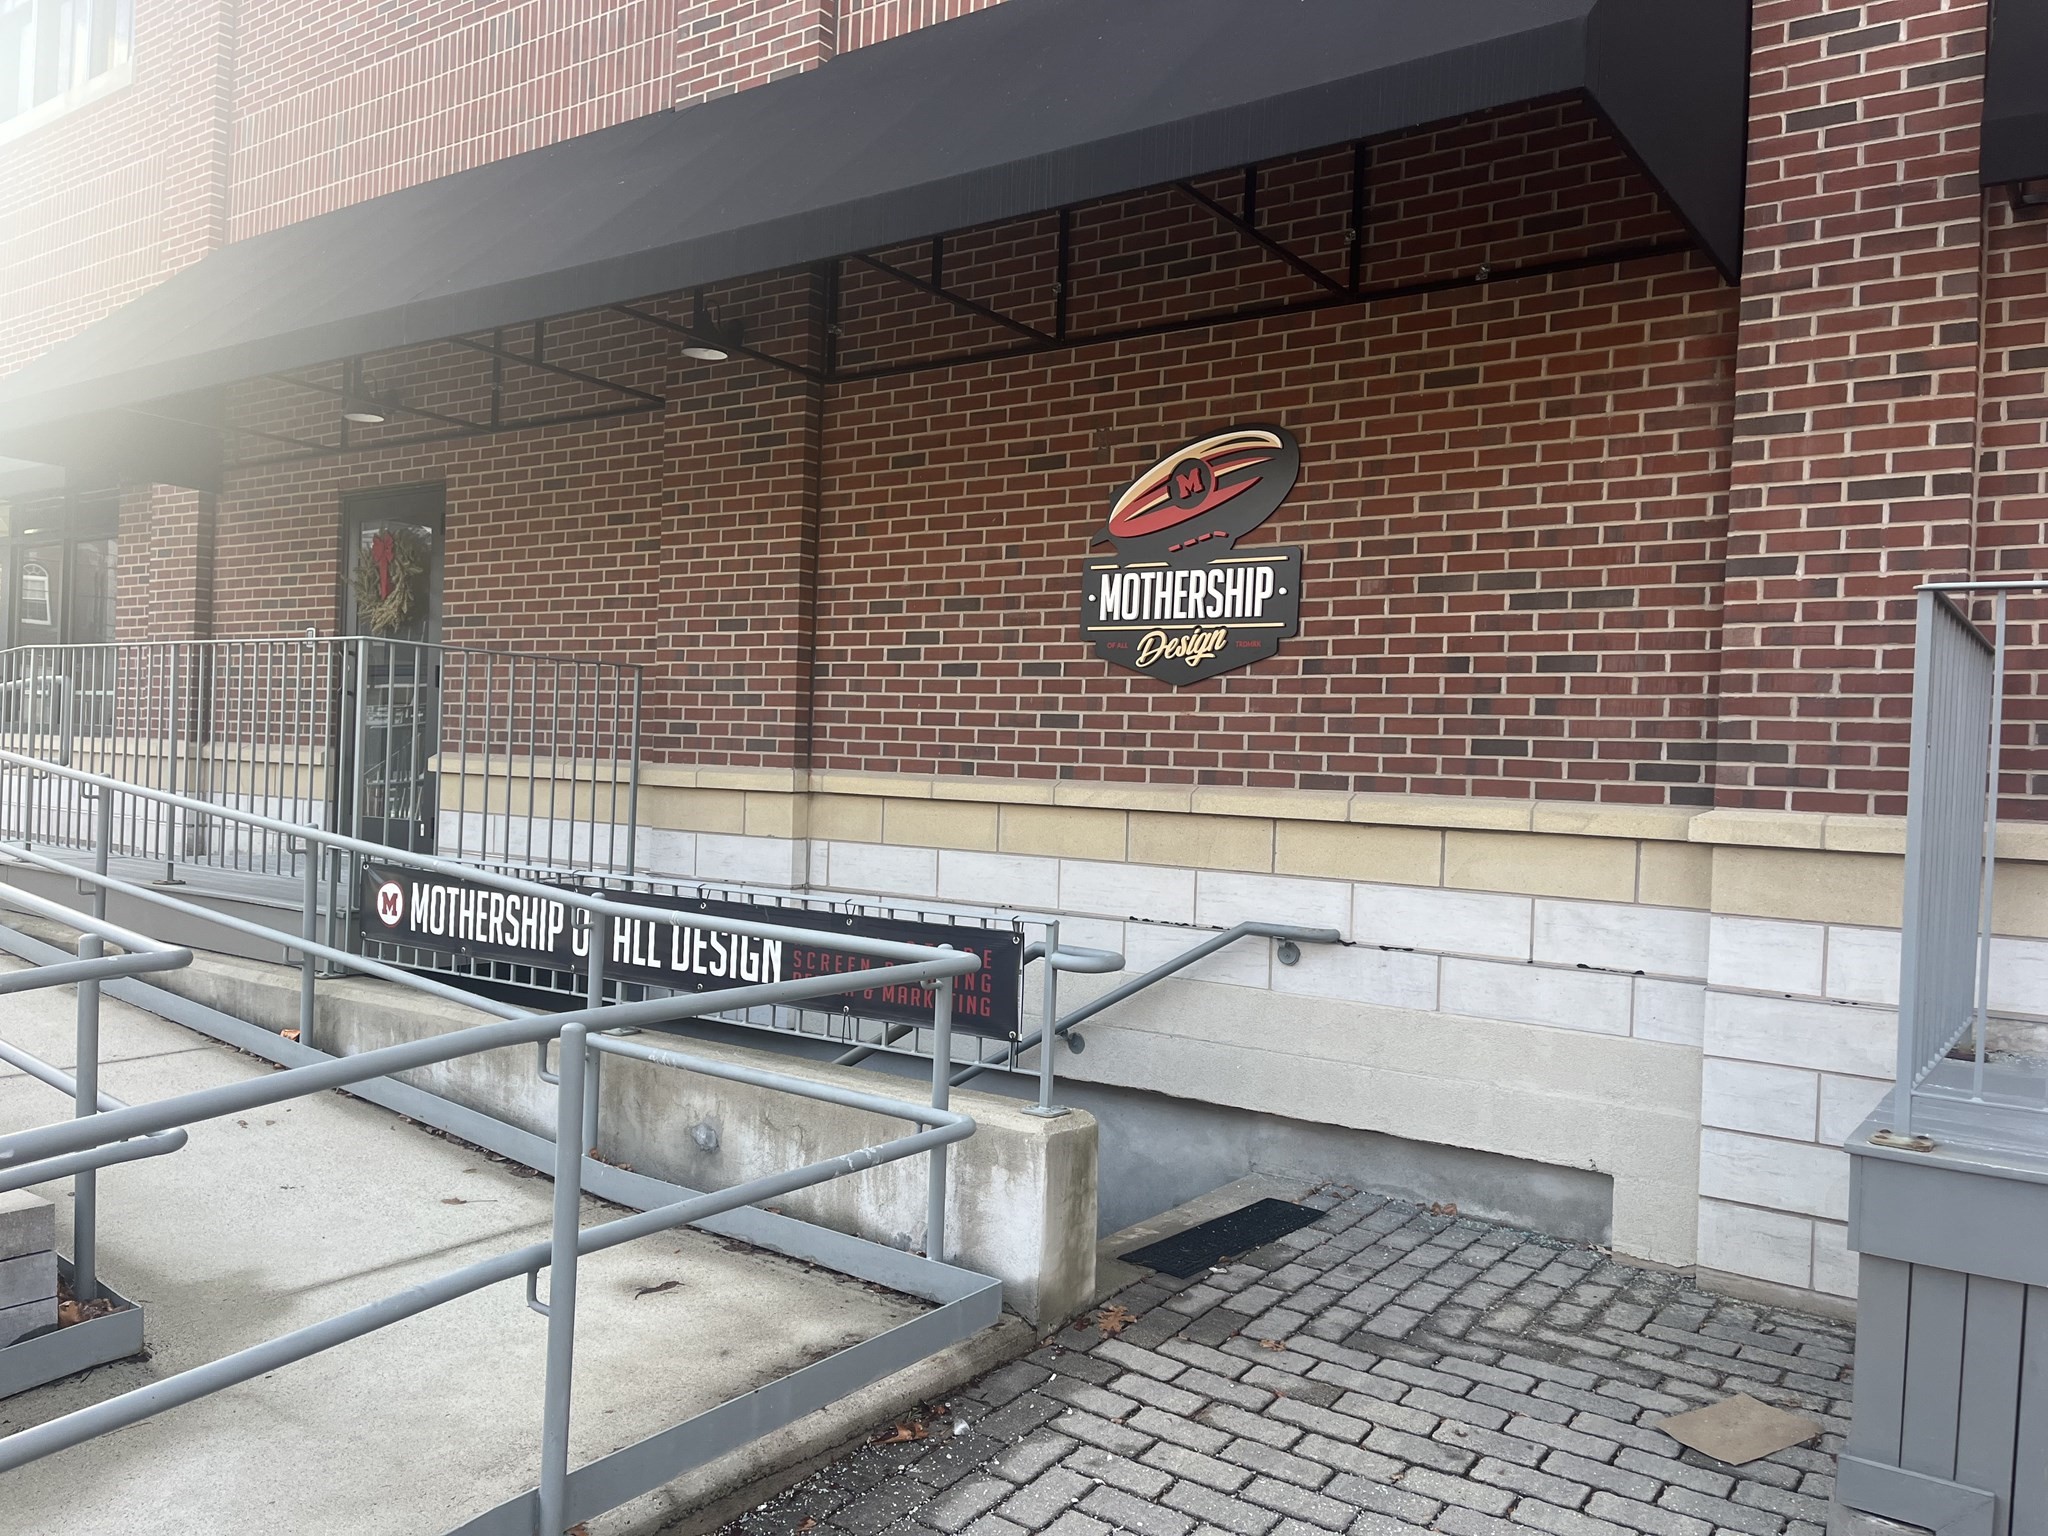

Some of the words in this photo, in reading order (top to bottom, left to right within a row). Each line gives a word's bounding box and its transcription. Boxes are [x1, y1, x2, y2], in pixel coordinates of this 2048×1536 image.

[1176, 467, 1204, 499] M
[1099, 566, 1275, 621] MOTHERSHIP
[1135, 626, 1228, 668] Design
[382, 892, 399, 915] M
[409, 882, 565, 953] MOTHERSHIP
[572, 907, 591, 957] O
[613, 916, 662, 969] ALL
[671, 925, 782, 984] DESIGN
[793, 949, 871, 973] SCREEN
[882, 983, 992, 1017] MARKING
